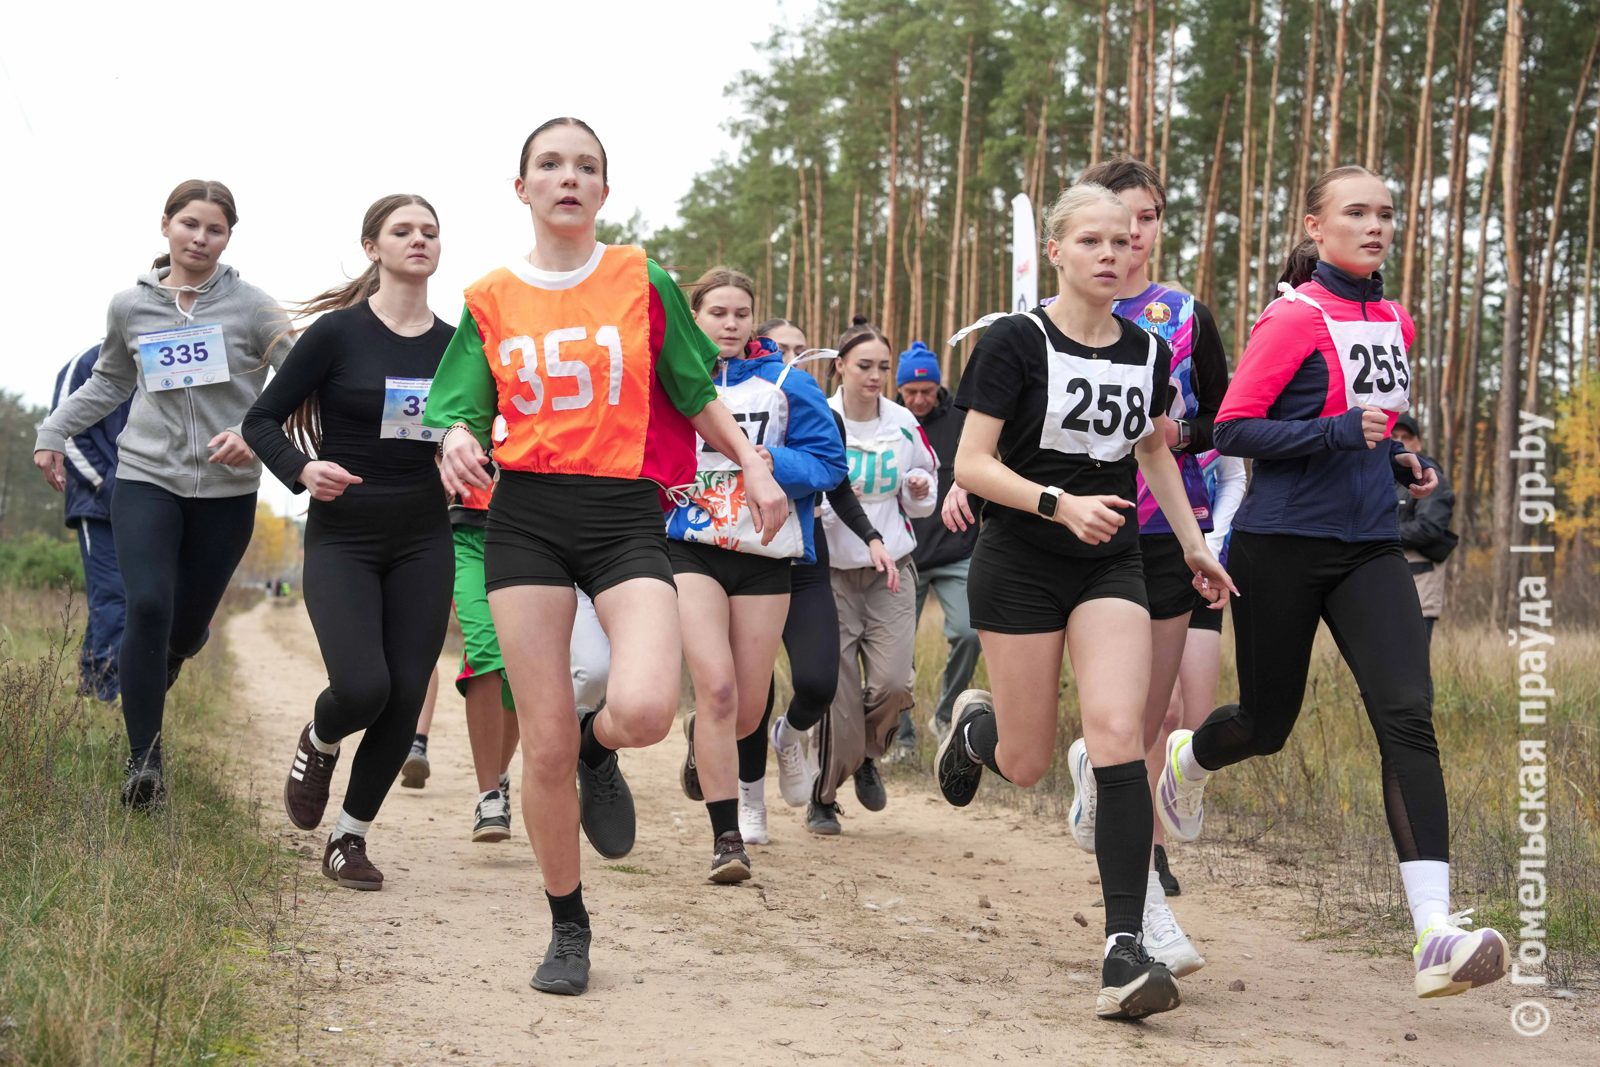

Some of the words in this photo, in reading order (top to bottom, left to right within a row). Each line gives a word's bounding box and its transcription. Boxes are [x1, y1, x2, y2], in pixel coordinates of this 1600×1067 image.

[159, 341, 209, 367] 335
[498, 325, 623, 416] 351
[1349, 343, 1409, 395] 255
[403, 395, 428, 417] 3
[1061, 377, 1147, 441] 258
